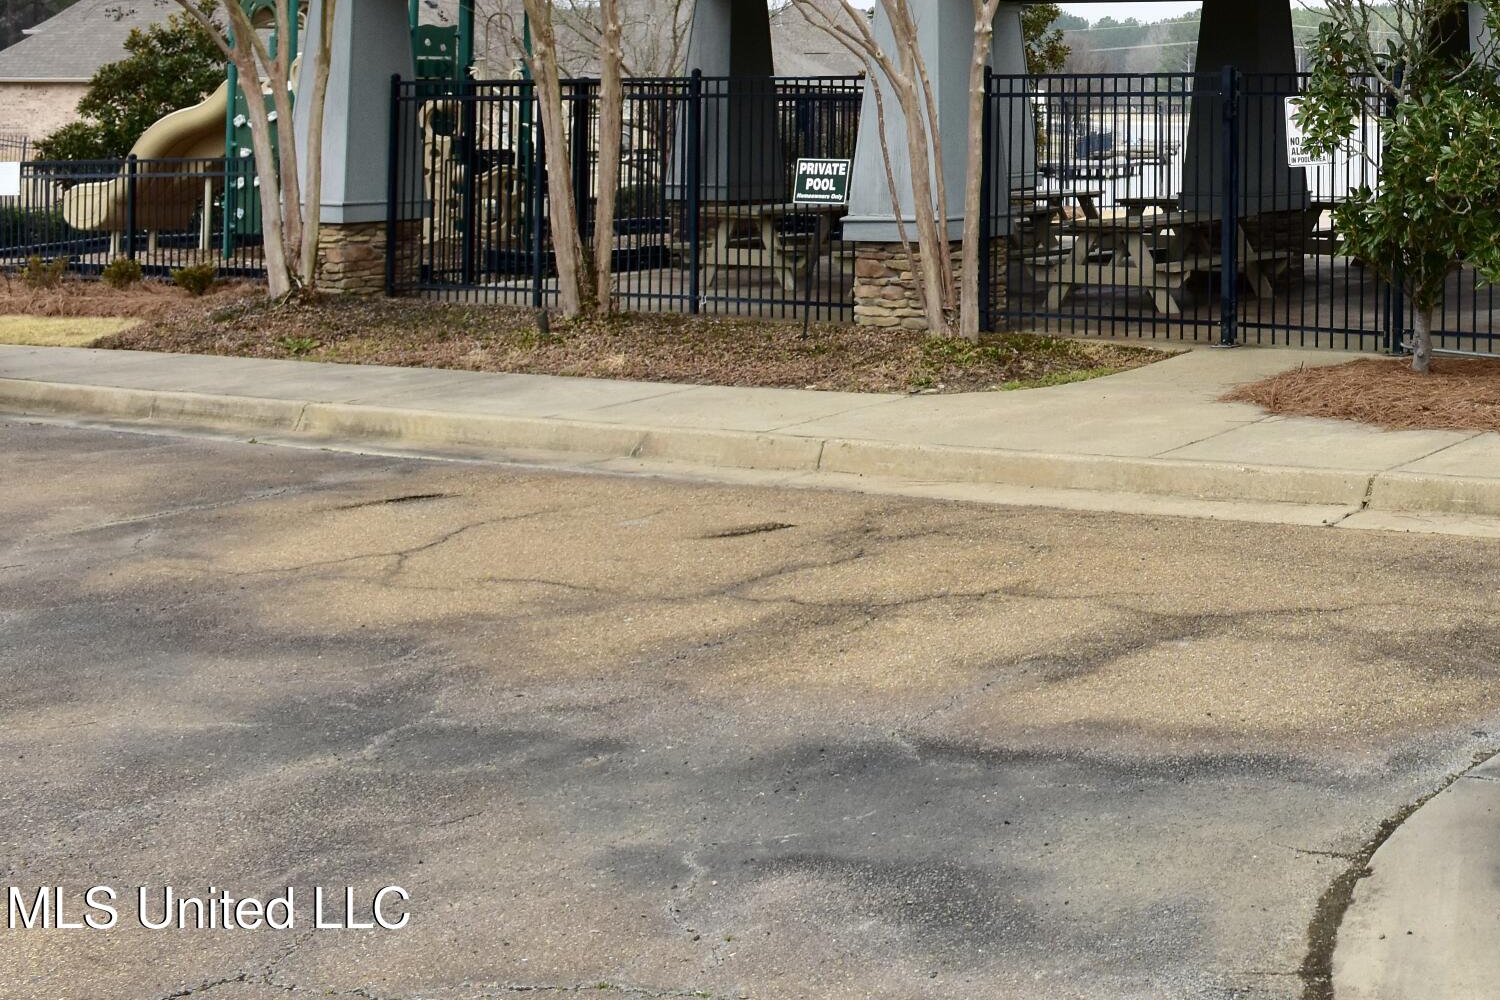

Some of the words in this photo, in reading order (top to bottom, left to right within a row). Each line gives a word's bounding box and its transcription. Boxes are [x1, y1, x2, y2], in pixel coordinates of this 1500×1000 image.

[1290, 136, 1300, 145] NO
[799, 162, 846, 175] PRIVATE
[805, 177, 836, 191] POOL
